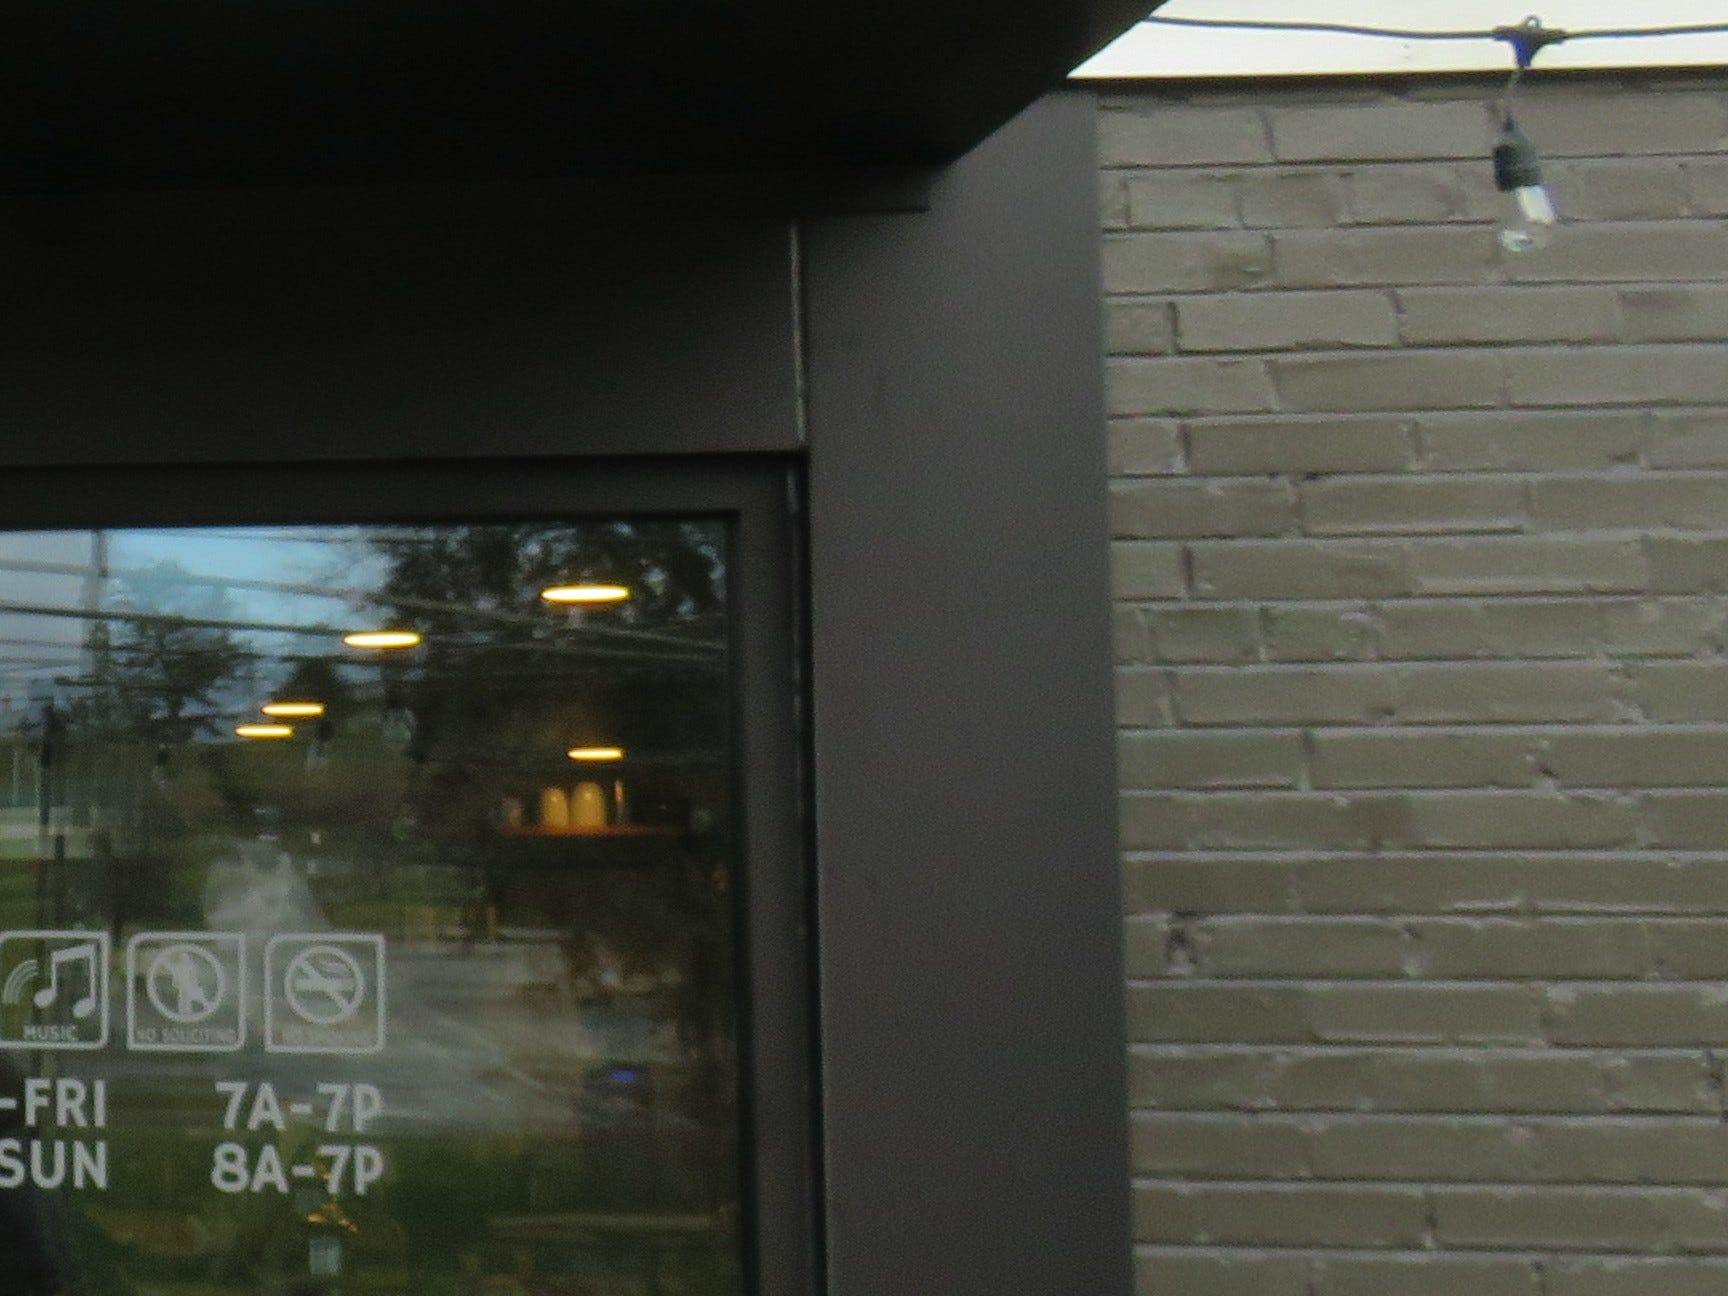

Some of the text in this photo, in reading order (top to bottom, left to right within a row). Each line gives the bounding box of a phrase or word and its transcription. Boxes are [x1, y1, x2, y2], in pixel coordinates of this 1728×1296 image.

[22, 1023, 80, 1042] MUSIC
[214, 1080, 383, 1133] 7A-7P
[210, 1142, 384, 1196] 8A-7P
